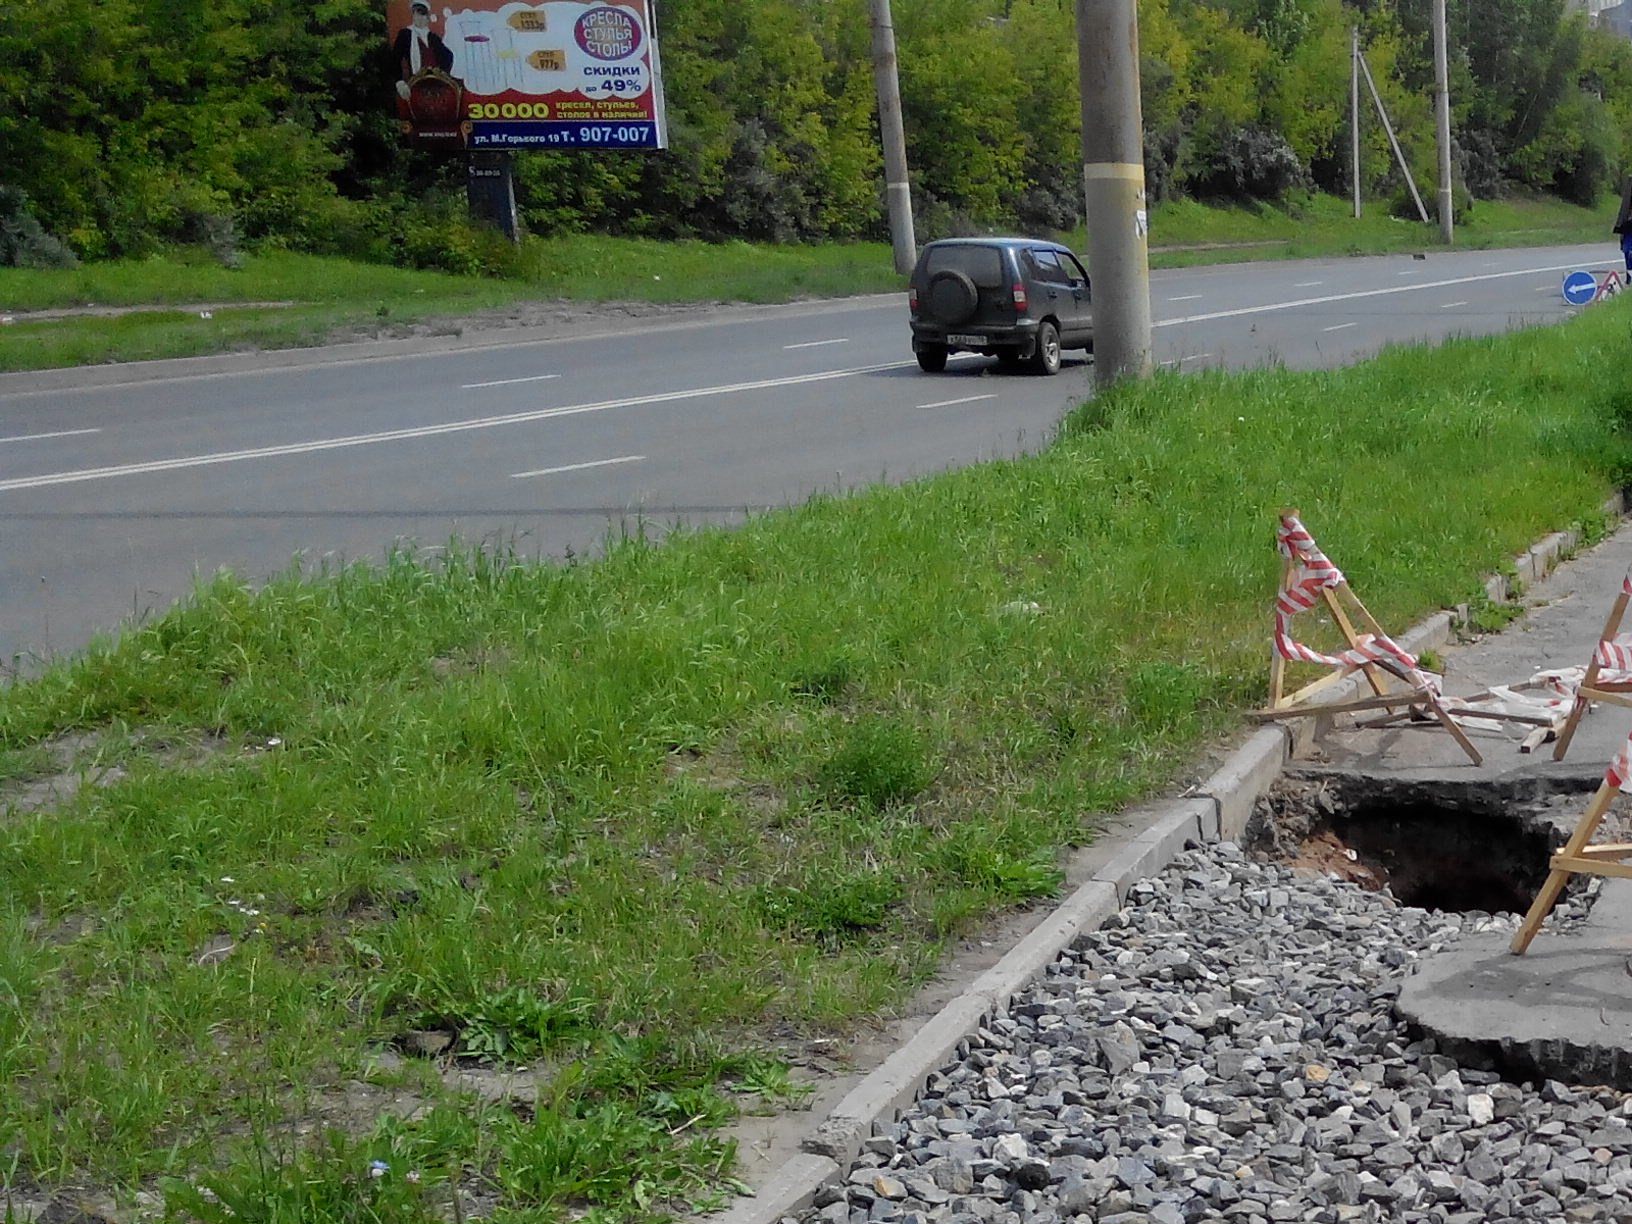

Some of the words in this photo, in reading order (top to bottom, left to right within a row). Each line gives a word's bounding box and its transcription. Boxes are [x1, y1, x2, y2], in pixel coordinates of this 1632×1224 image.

[582, 11, 633, 29] КРЕСЛА
[583, 27, 633, 41] СТУЛЬЯ
[585, 40, 633, 57] СТОЛЫ
[601, 79, 641, 91] 49%
[548, 134, 560, 142] 19
[580, 126, 649, 142] 907-007
